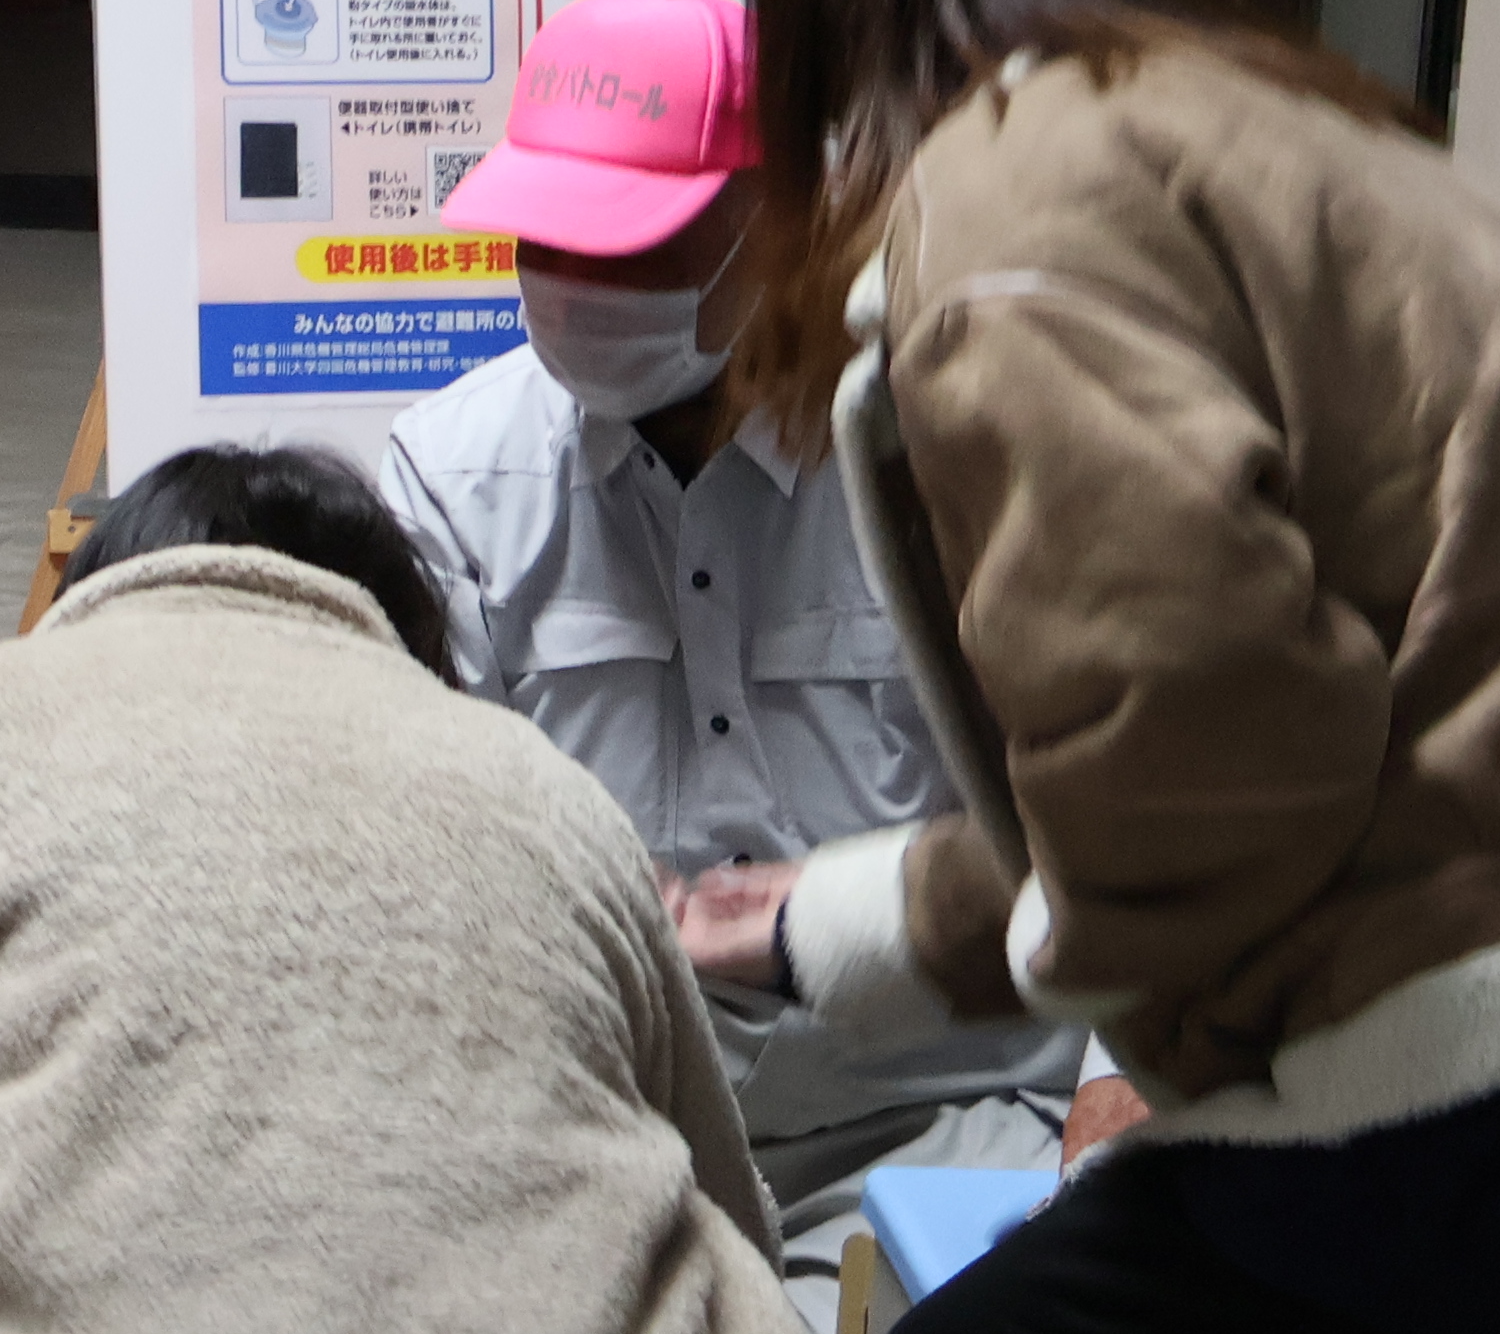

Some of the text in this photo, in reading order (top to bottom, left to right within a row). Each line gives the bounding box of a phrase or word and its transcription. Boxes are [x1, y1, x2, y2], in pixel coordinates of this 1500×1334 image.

[338, 100, 475, 116] 便器取付型使い捨て
[369, 169, 408, 185] 詳しい
[369, 187, 421, 202] 使い方は
